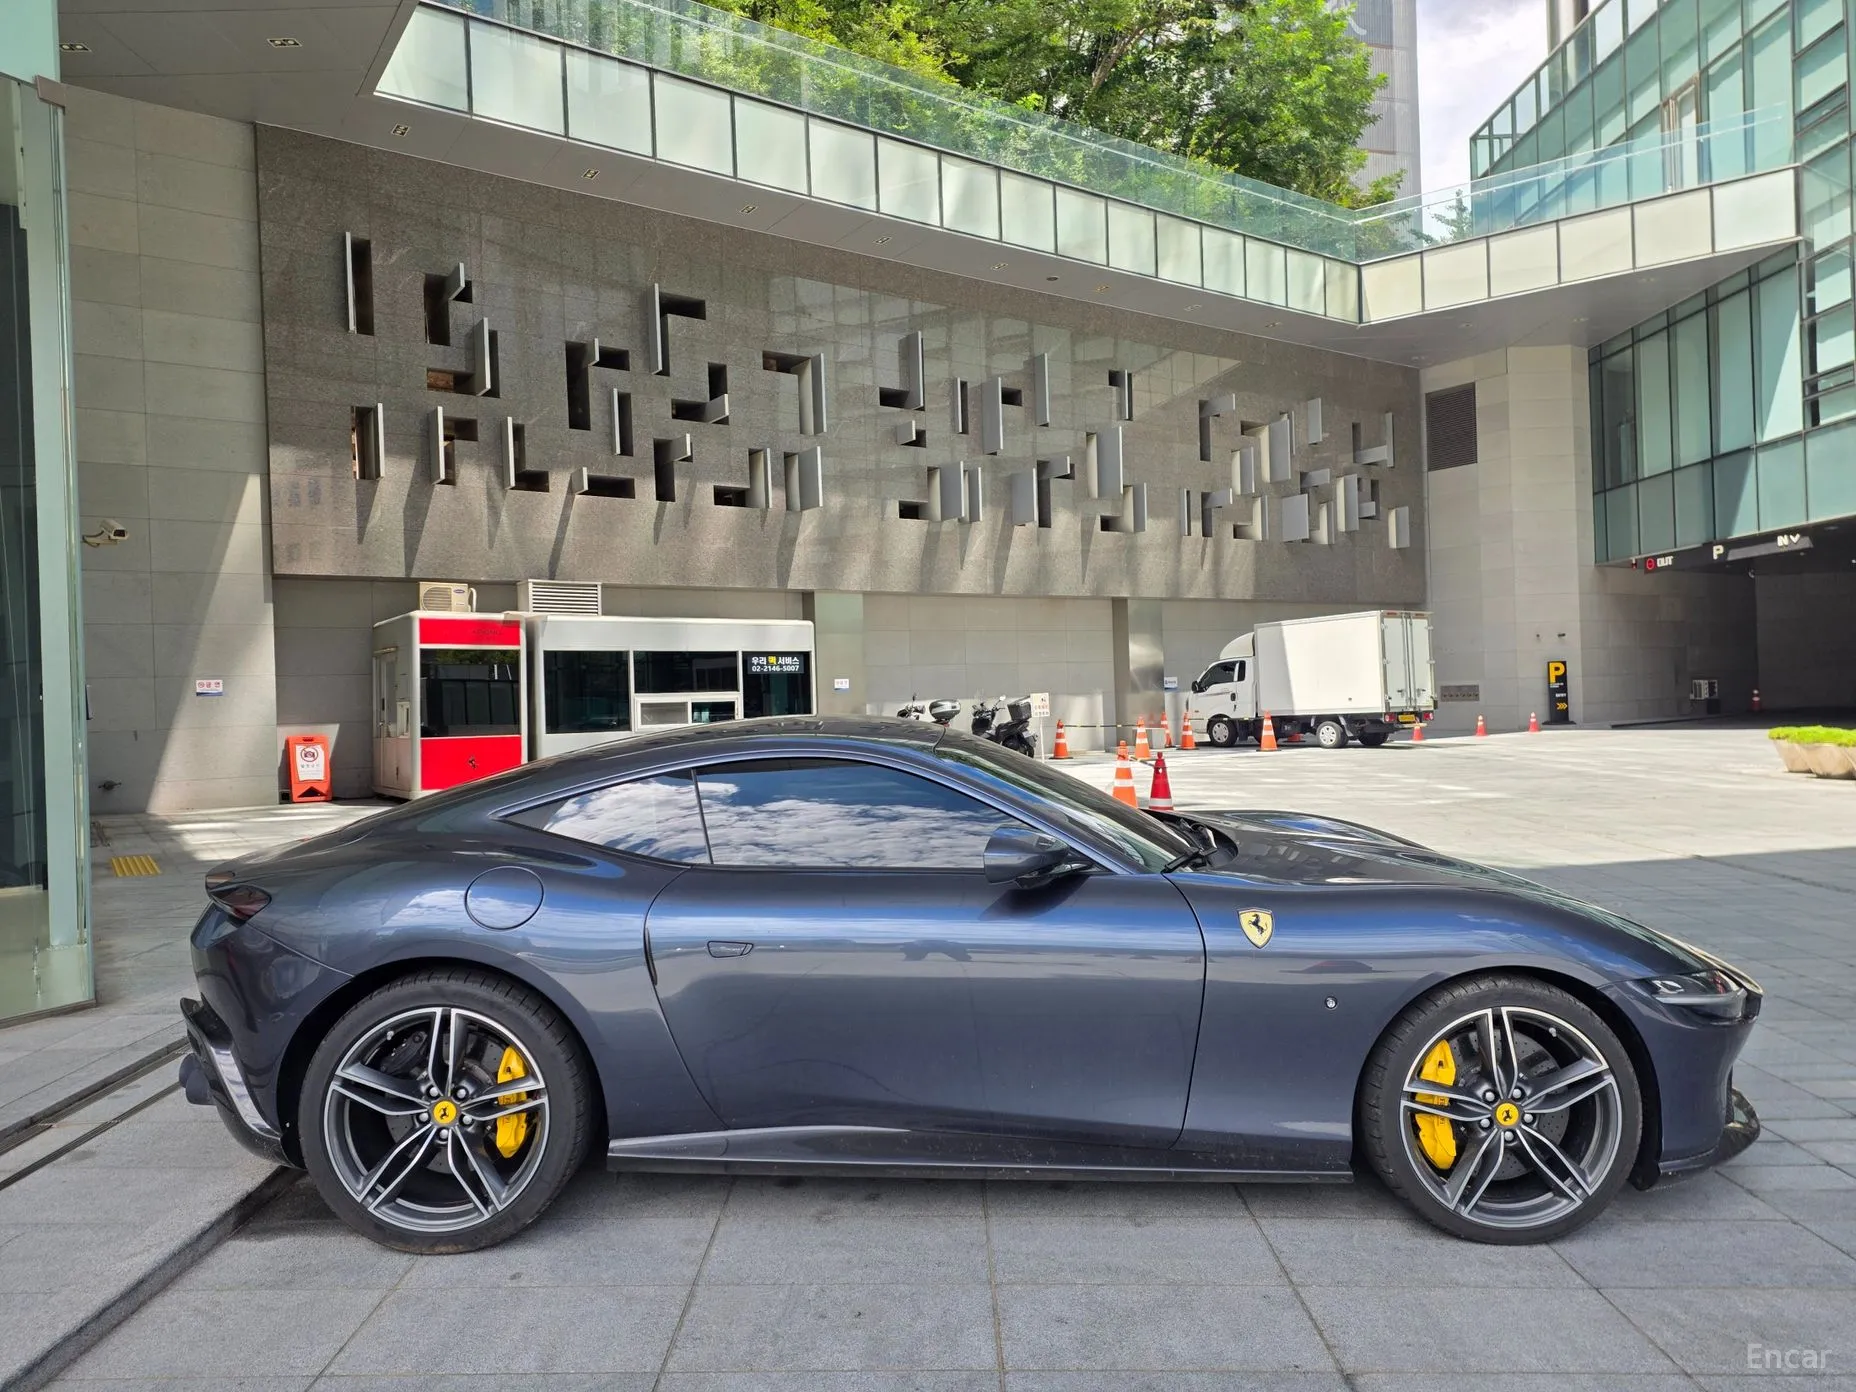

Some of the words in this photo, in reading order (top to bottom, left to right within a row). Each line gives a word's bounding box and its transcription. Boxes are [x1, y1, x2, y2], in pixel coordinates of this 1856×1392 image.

[1713, 546, 1724, 560] P
[1656, 555, 1674, 567] OUT
[751, 656, 766, 665] 우리
[777, 656, 799, 665] 서비스
[1549, 661, 1566, 683] P
